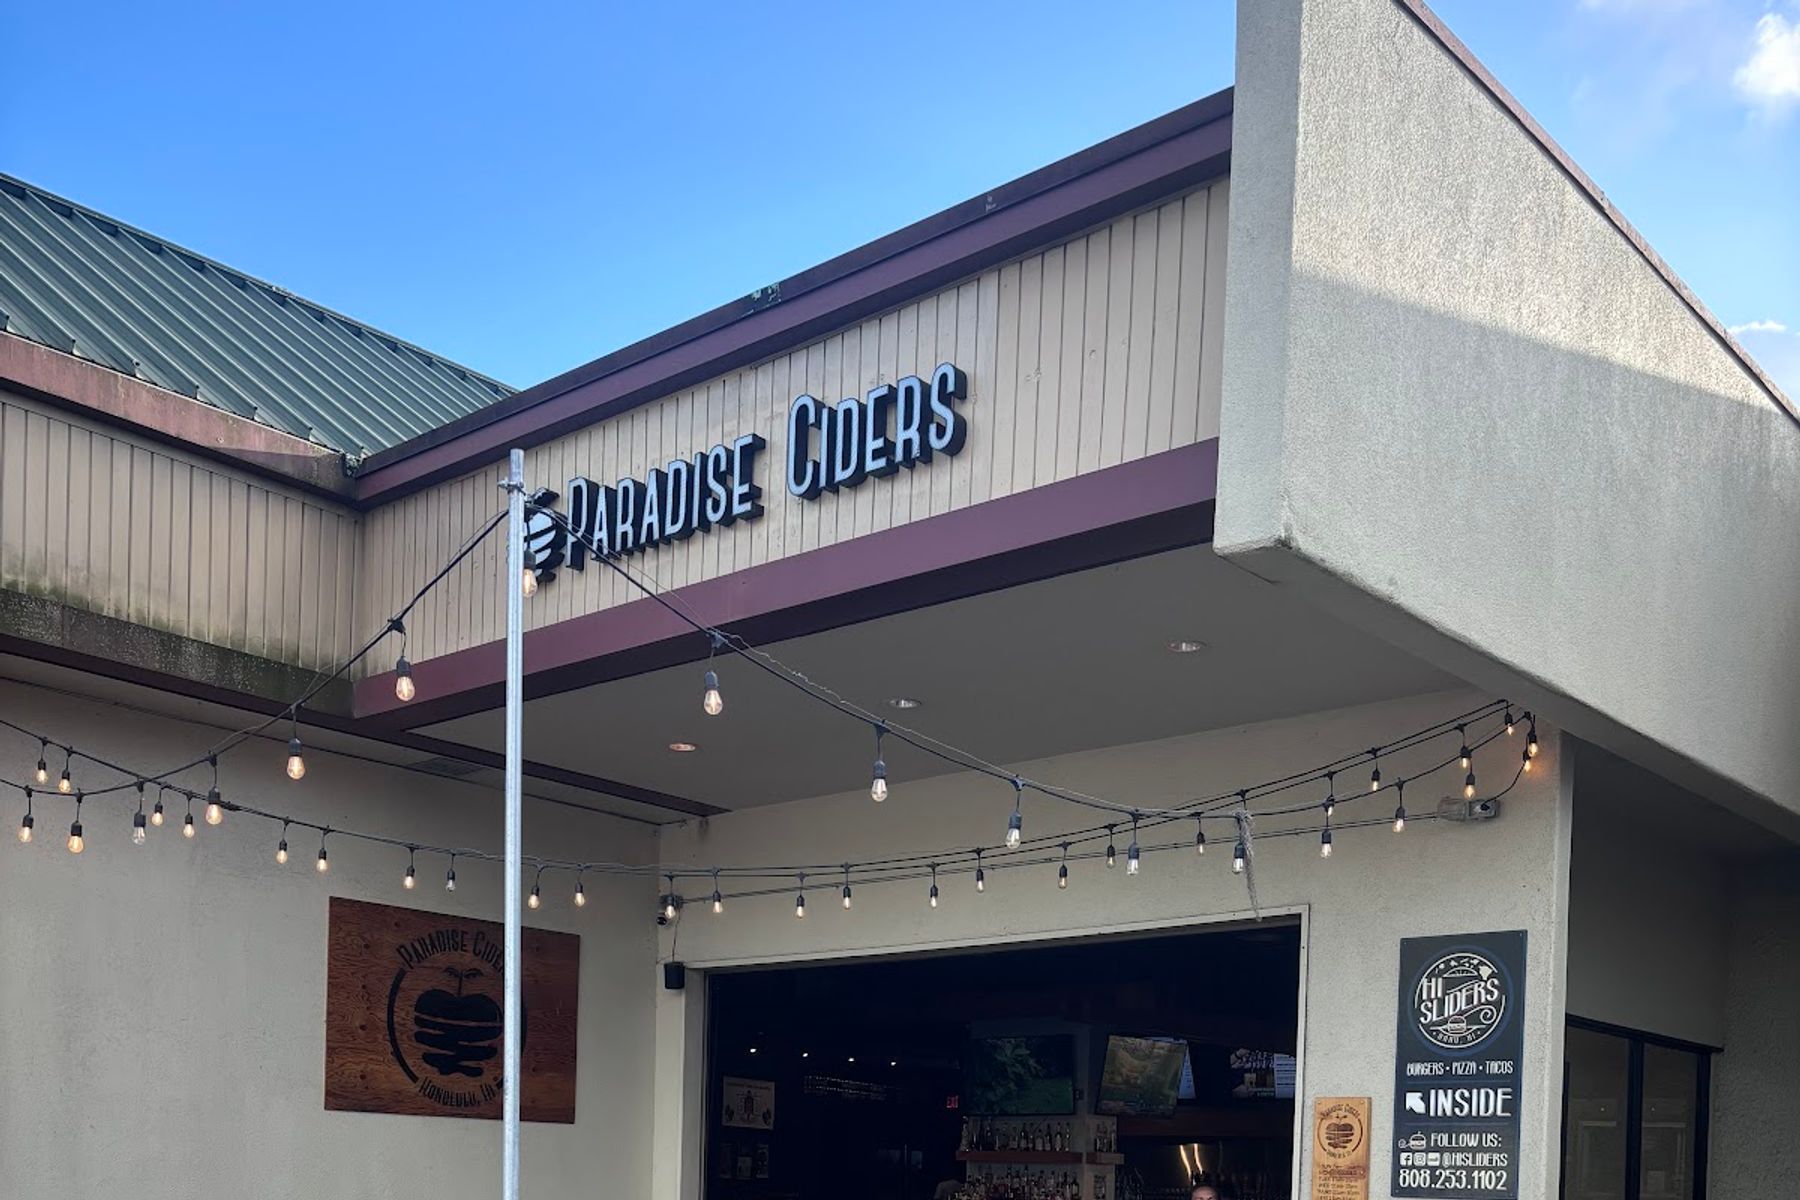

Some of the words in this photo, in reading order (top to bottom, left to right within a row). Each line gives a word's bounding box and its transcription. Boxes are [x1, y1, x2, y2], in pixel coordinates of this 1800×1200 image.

[565, 432, 766, 572] PARADISE
[786, 361, 968, 501] CIDERS
[396, 929, 469, 970] PARADISE
[1421, 977, 1443, 1000] HI
[1420, 978, 1500, 1024] SLIDERS
[1406, 1061, 1444, 1076] BURGERS
[1452, 1061, 1477, 1075] PIZZA
[1485, 1060, 1514, 1075] TACOS
[1429, 1087, 1513, 1118] INSIDE
[1430, 1132, 1480, 1148] FOLLOW
[1482, 1132, 1503, 1148] US:
[1442, 1152, 1508, 1168] @HISLIDERS
[1399, 1168, 1508, 1191] 808.253.1102
